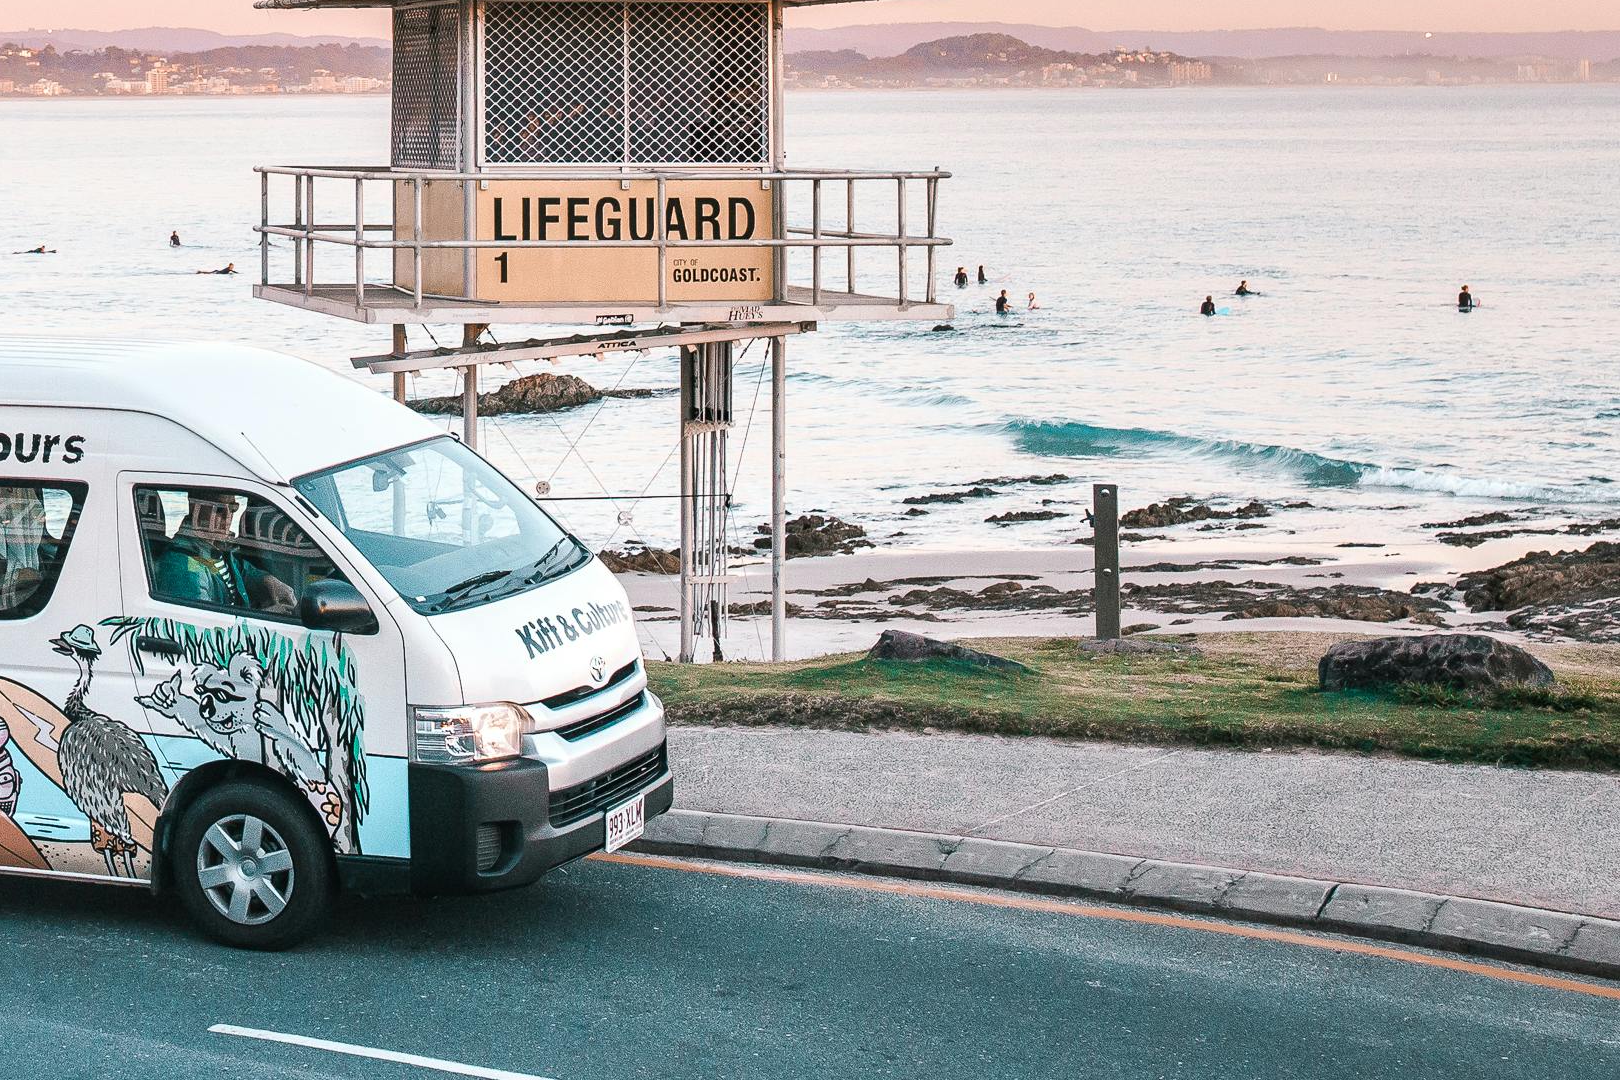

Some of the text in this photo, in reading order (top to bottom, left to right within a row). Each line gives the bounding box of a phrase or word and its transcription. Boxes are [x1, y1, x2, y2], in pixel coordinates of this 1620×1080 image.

[494, 197, 756, 240] LIFEGUARD
[494, 252, 509, 283] 1
[690, 258, 699, 266] OF
[597, 340, 637, 349] ATTICA
[515, 600, 629, 660] Kiff & Culture
